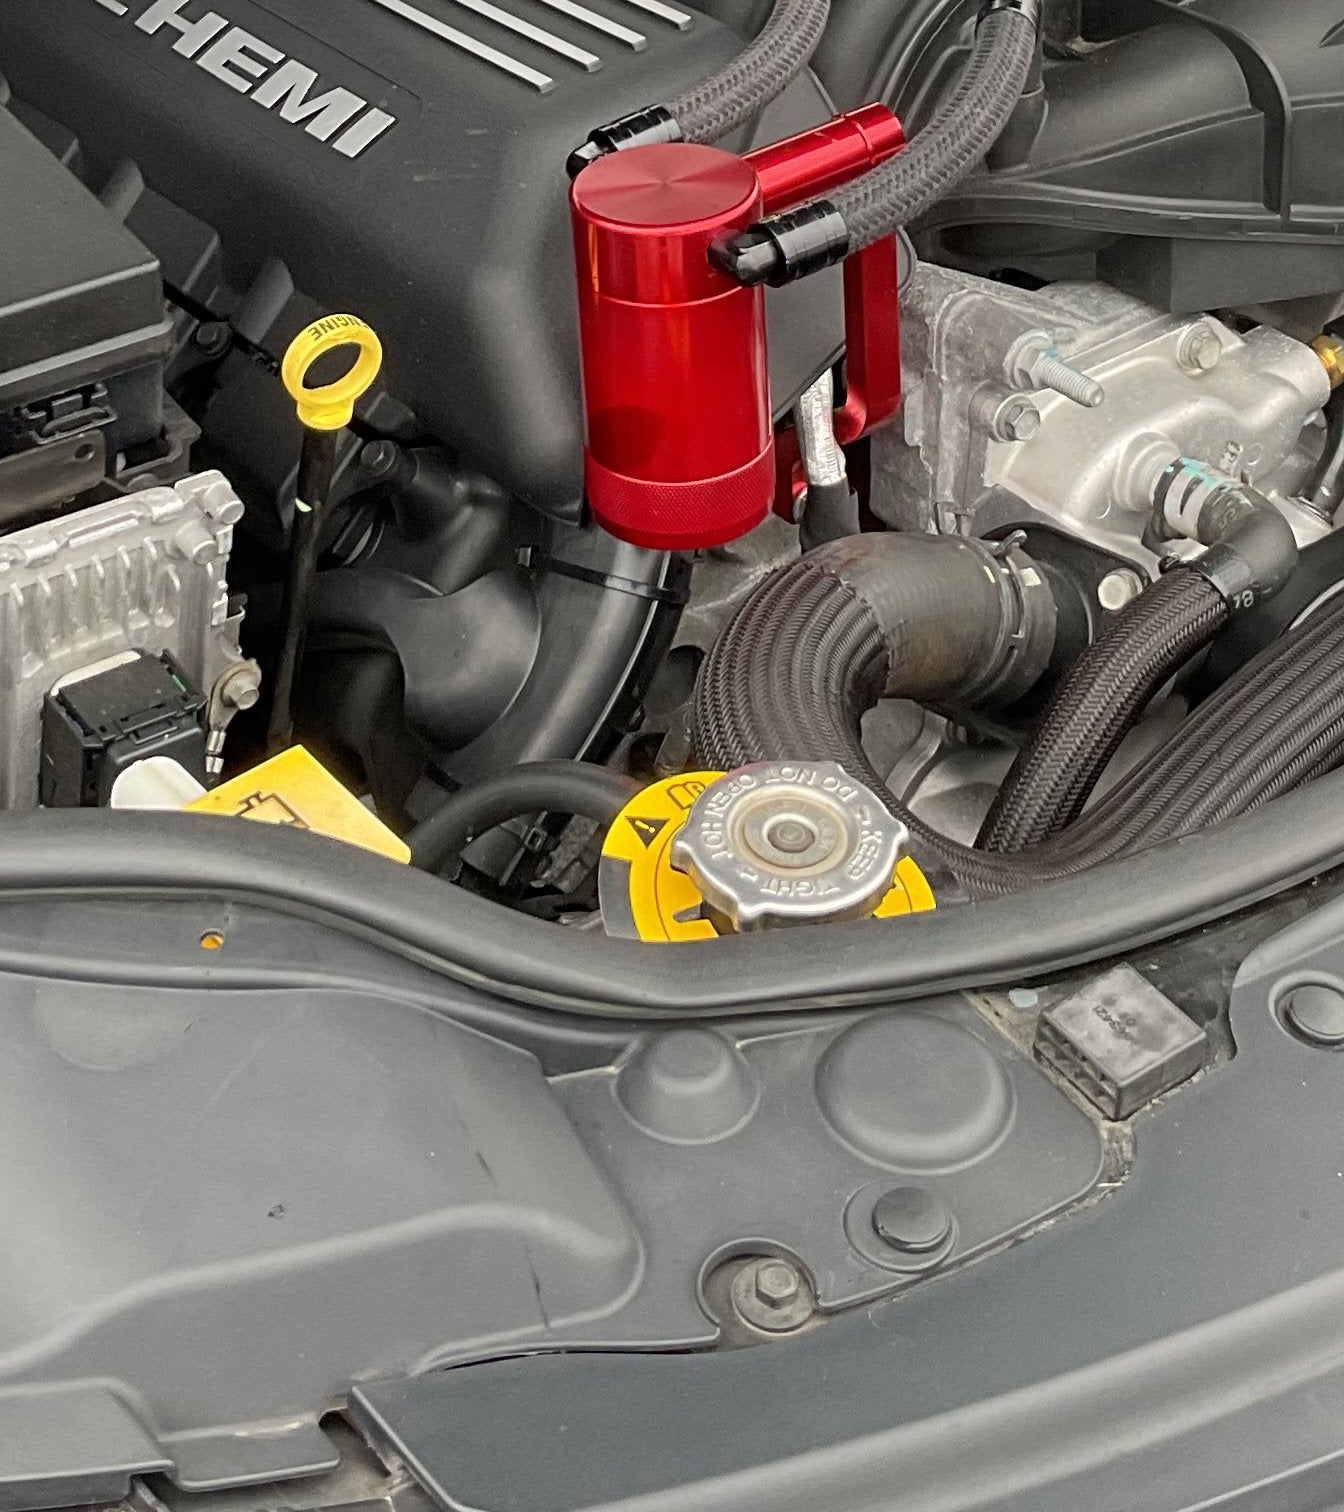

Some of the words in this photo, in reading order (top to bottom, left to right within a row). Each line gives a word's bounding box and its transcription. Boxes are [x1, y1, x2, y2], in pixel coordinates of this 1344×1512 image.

[308, 315, 369, 342] NGINE
[765, 767, 817, 785] NOT
[822, 776, 858, 802] DO
[705, 774, 757, 817] OPEN
[701, 822, 733, 860] HOT
[847, 830, 883, 880] KEEP
[759, 878, 841, 897] TIGHT
